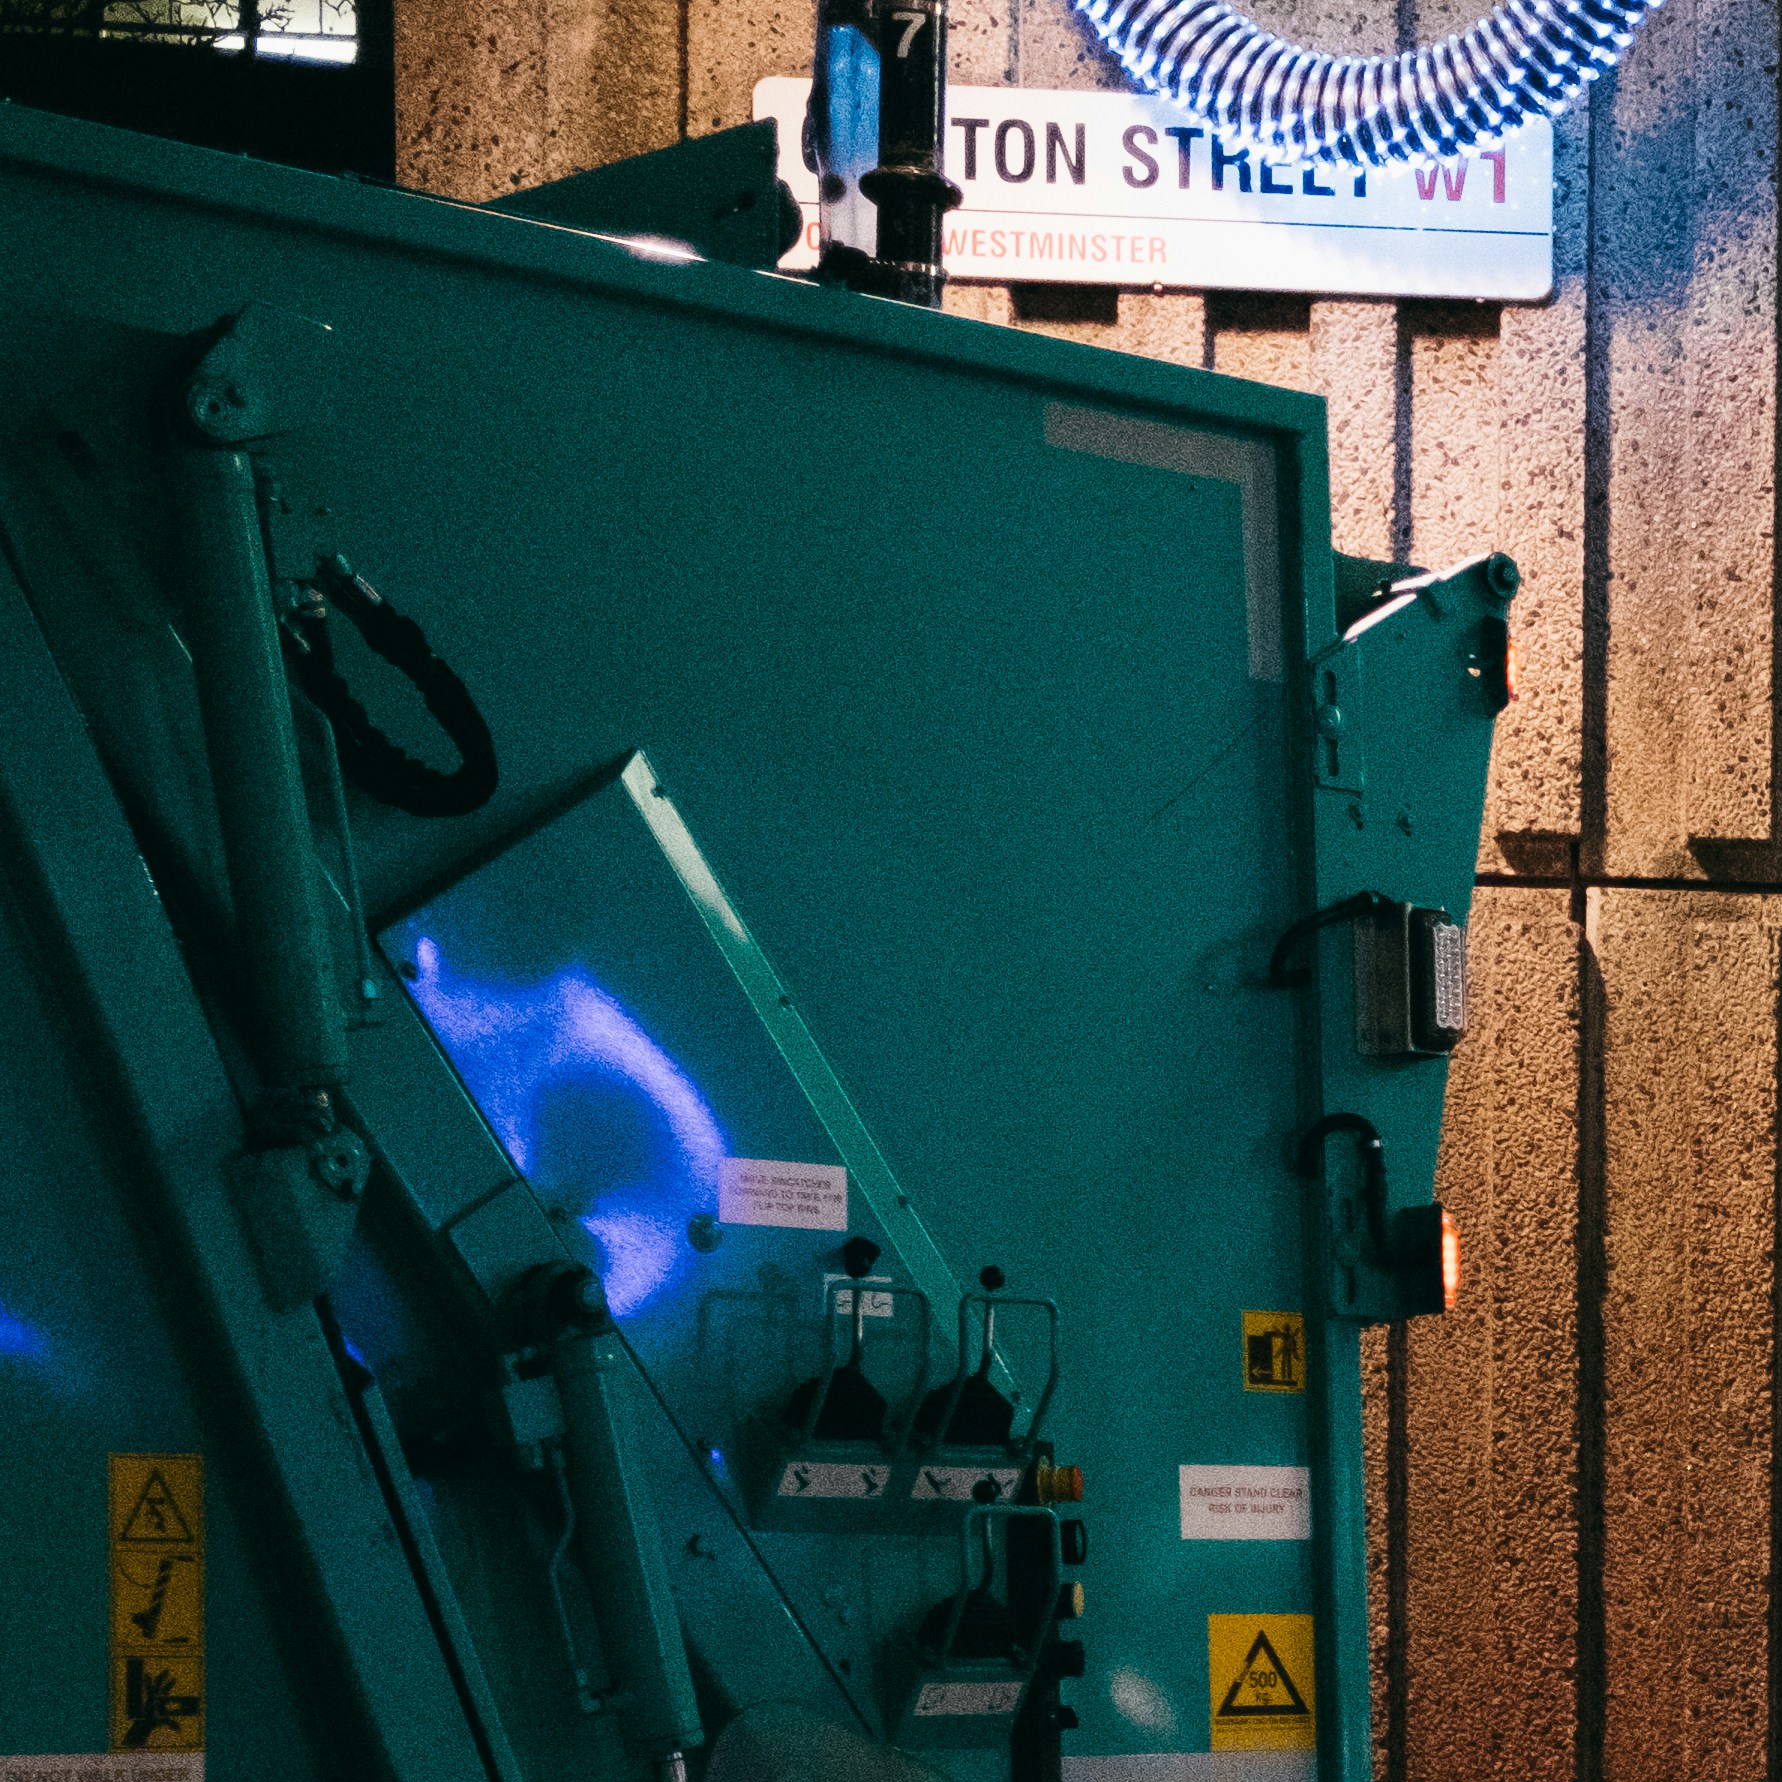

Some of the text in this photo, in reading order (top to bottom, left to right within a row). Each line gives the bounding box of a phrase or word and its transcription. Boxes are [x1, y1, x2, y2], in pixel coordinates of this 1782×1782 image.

[891, 12, 927, 58] 7
[1121, 124, 1368, 198] STRE
[1415, 142, 1506, 204] W1
[941, 228, 1167, 264] WESTMINSTER
[1189, 1486, 1303, 1500] DANGER STAND CLEAR
[1208, 1503, 1284, 1514] RISK OF INJURY
[1249, 1670, 1278, 1689] 500
